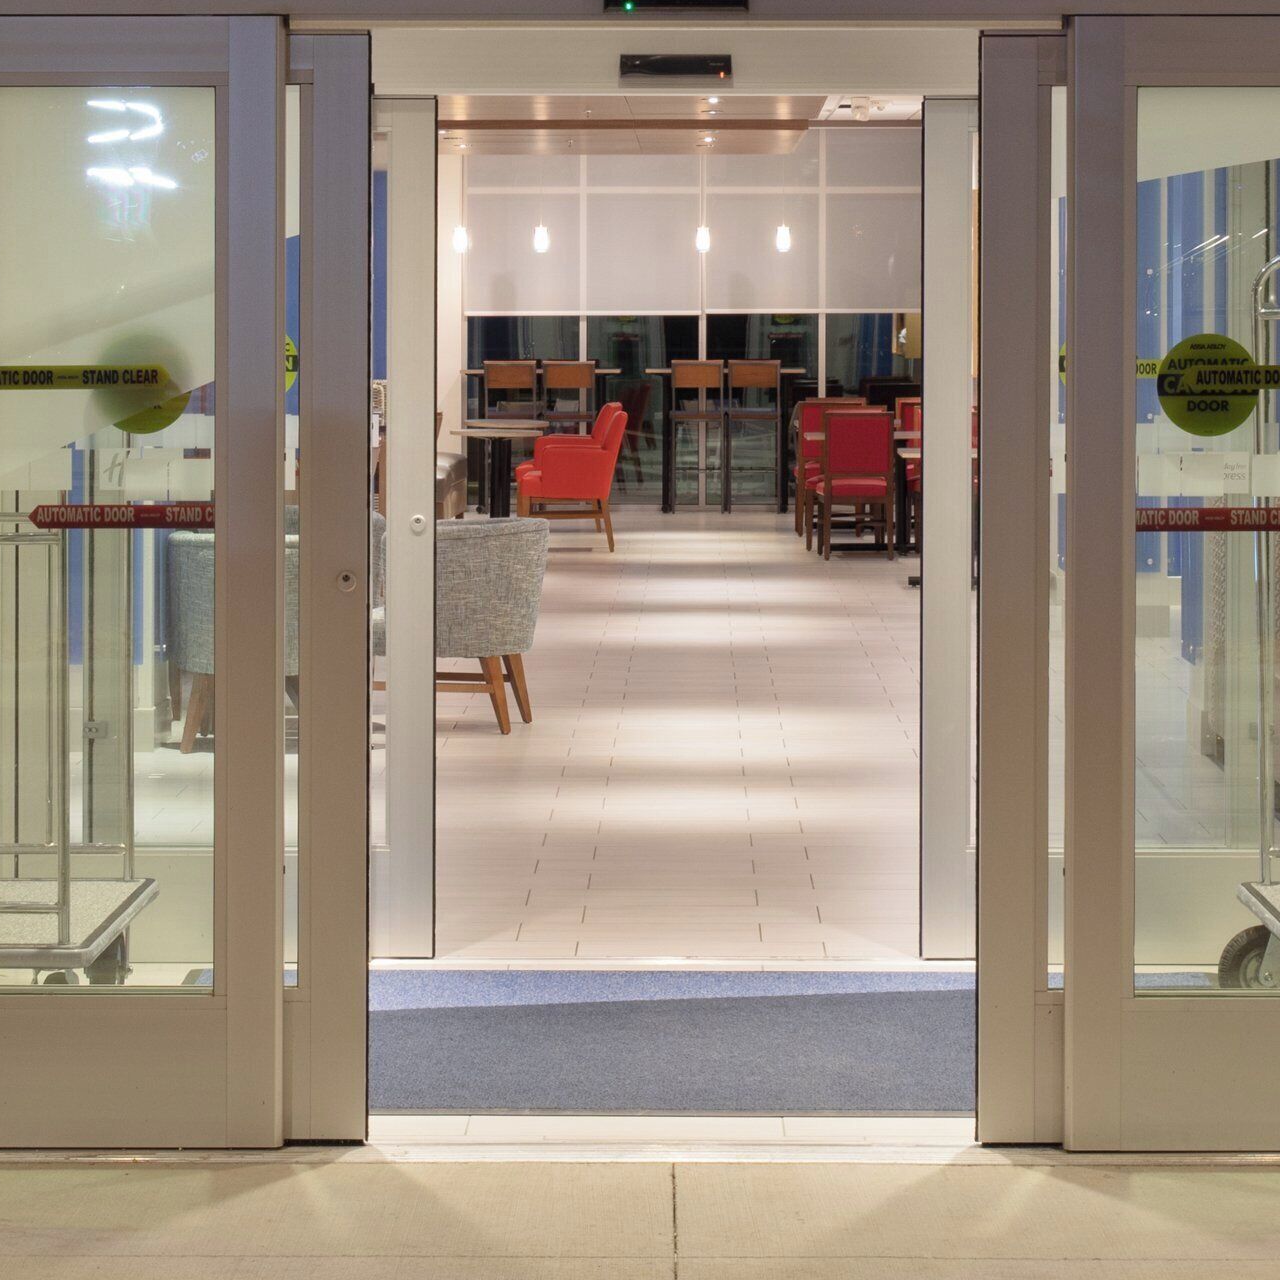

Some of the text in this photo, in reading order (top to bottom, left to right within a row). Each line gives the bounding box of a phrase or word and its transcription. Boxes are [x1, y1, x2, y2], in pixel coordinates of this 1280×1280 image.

[22, 370, 54, 386] DOOR
[82, 369, 119, 385] STAND
[122, 368, 159, 385] CLEAR
[1195, 369, 1261, 385] AUTOMATIC
[1186, 400, 1230, 412] DOOR
[36, 506, 101, 523] AUTOMATIC
[104, 506, 135, 523] DOOR
[165, 506, 202, 522] STAND
[1168, 509, 1200, 526] DOOR
[1230, 509, 1267, 526] STAND
